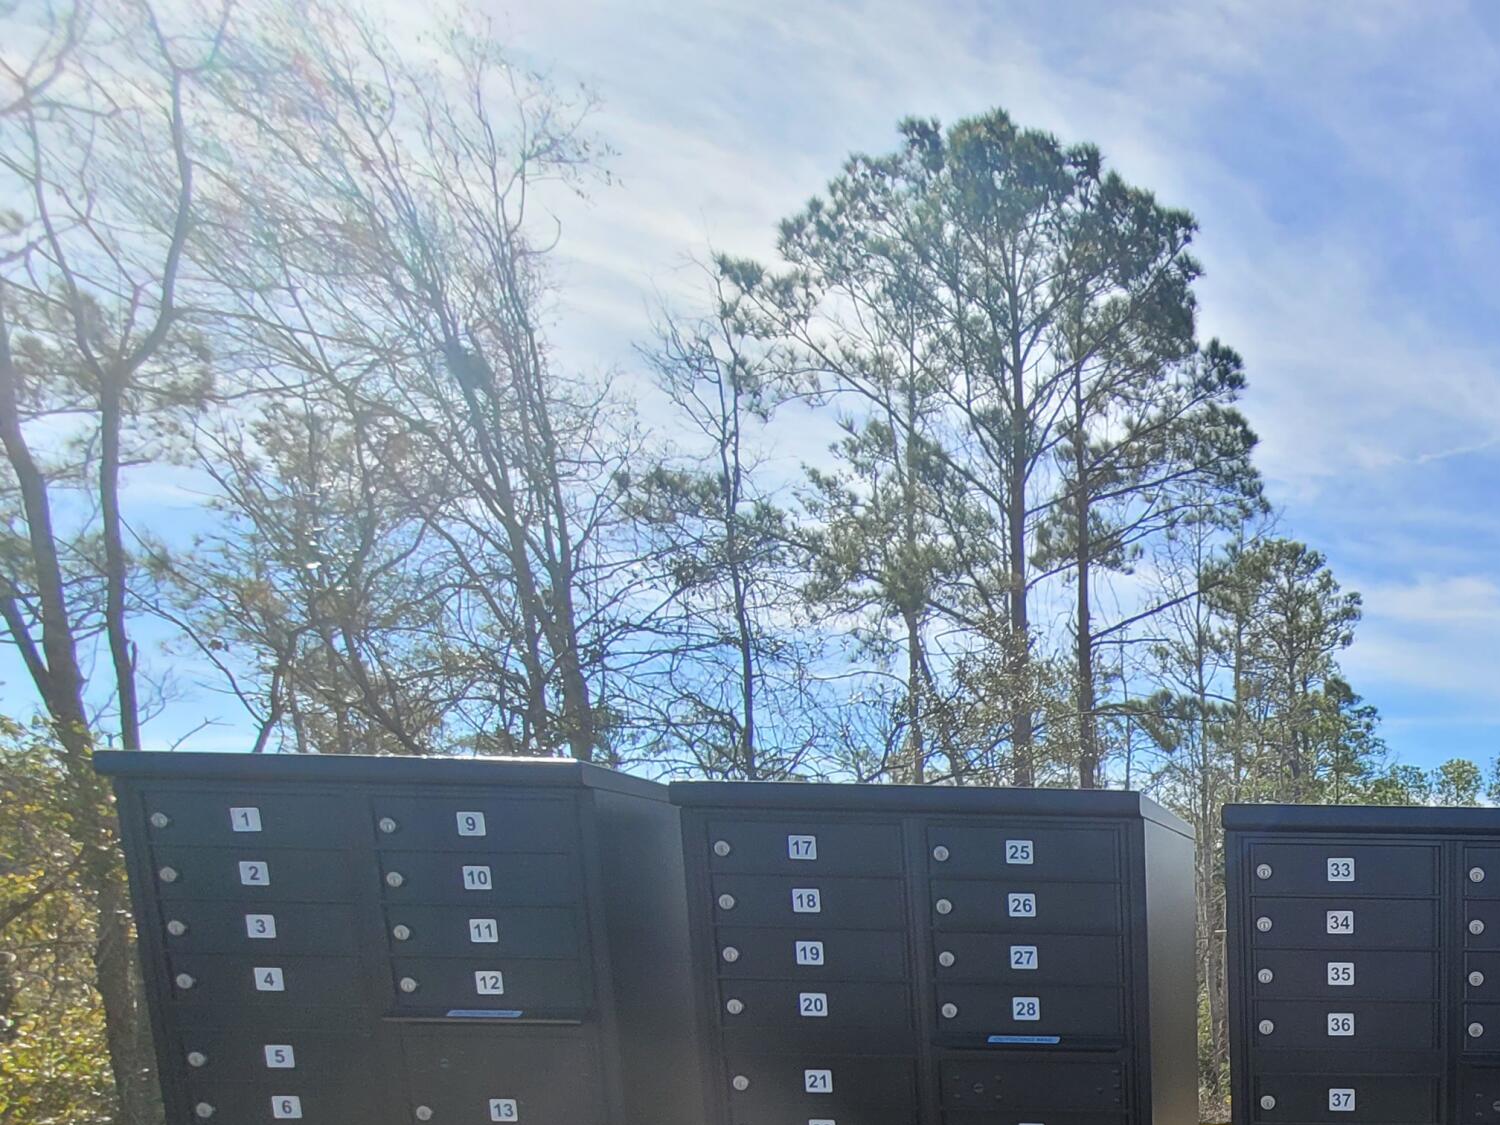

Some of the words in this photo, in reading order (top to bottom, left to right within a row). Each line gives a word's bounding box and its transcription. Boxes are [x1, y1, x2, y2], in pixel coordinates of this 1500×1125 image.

[240, 811, 250, 828] 1
[464, 815, 477, 833] 9
[791, 839, 813, 856] 17
[1008, 844, 1031, 861] 25
[247, 865, 261, 882] 2
[466, 869, 489, 886] 10
[1330, 861, 1352, 878] 33
[795, 892, 817, 909] 18
[1011, 897, 1033, 914] 26
[255, 918, 267, 935] 3
[473, 922, 493, 939] 11
[1329, 914, 1351, 931] 34
[799, 945, 821, 962] 19
[1013, 949, 1035, 966] 27
[263, 971, 275, 987] 4
[1330, 966, 1352, 982] 35
[479, 975, 501, 991] 12
[802, 997, 824, 1013] 20
[1015, 1001, 1037, 1017] 28
[1330, 1017, 1351, 1033] 36
[274, 1049, 286, 1065] 5
[807, 1073, 827, 1089] 21
[281, 1099, 293, 1115] 6
[1331, 1092, 1353, 1108] 37
[493, 1102, 515, 1119] 13
